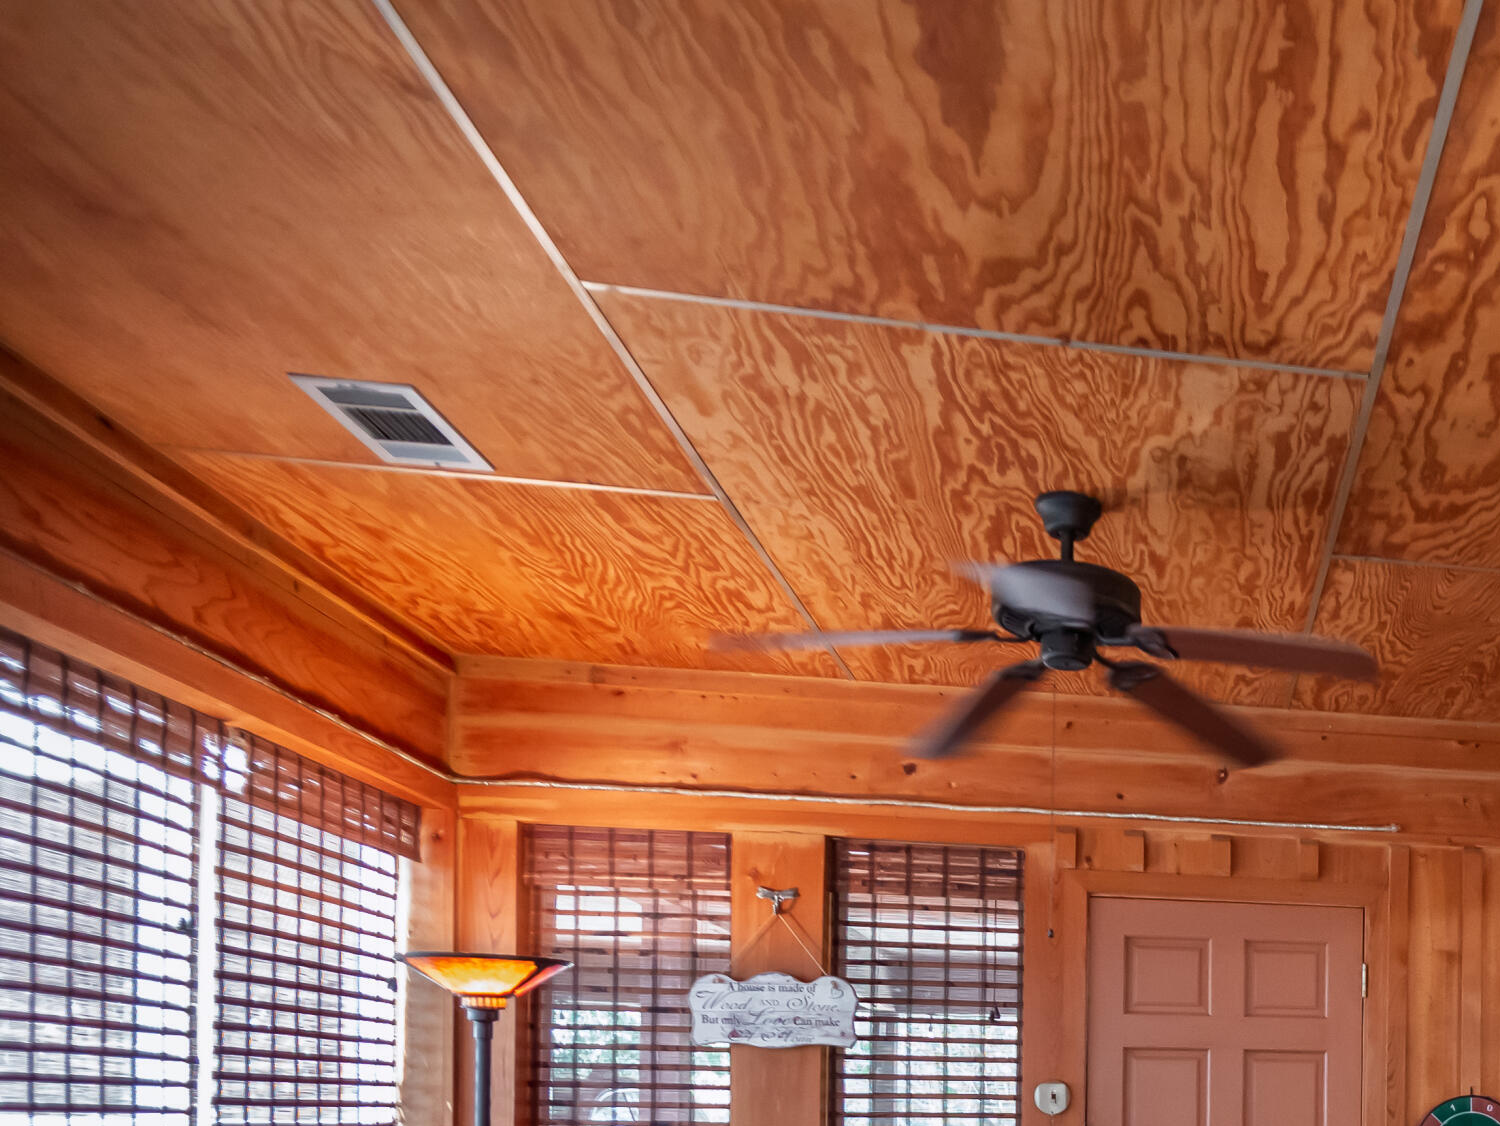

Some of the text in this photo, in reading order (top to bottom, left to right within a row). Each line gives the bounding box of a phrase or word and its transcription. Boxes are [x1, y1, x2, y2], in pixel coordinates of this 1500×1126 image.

[727, 982, 818, 996] A house is made of
[695, 990, 753, 1010] Wood
[701, 1014, 719, 1024] But
[815, 1016, 841, 1027] make
[1486, 1104, 1494, 1112] 0
